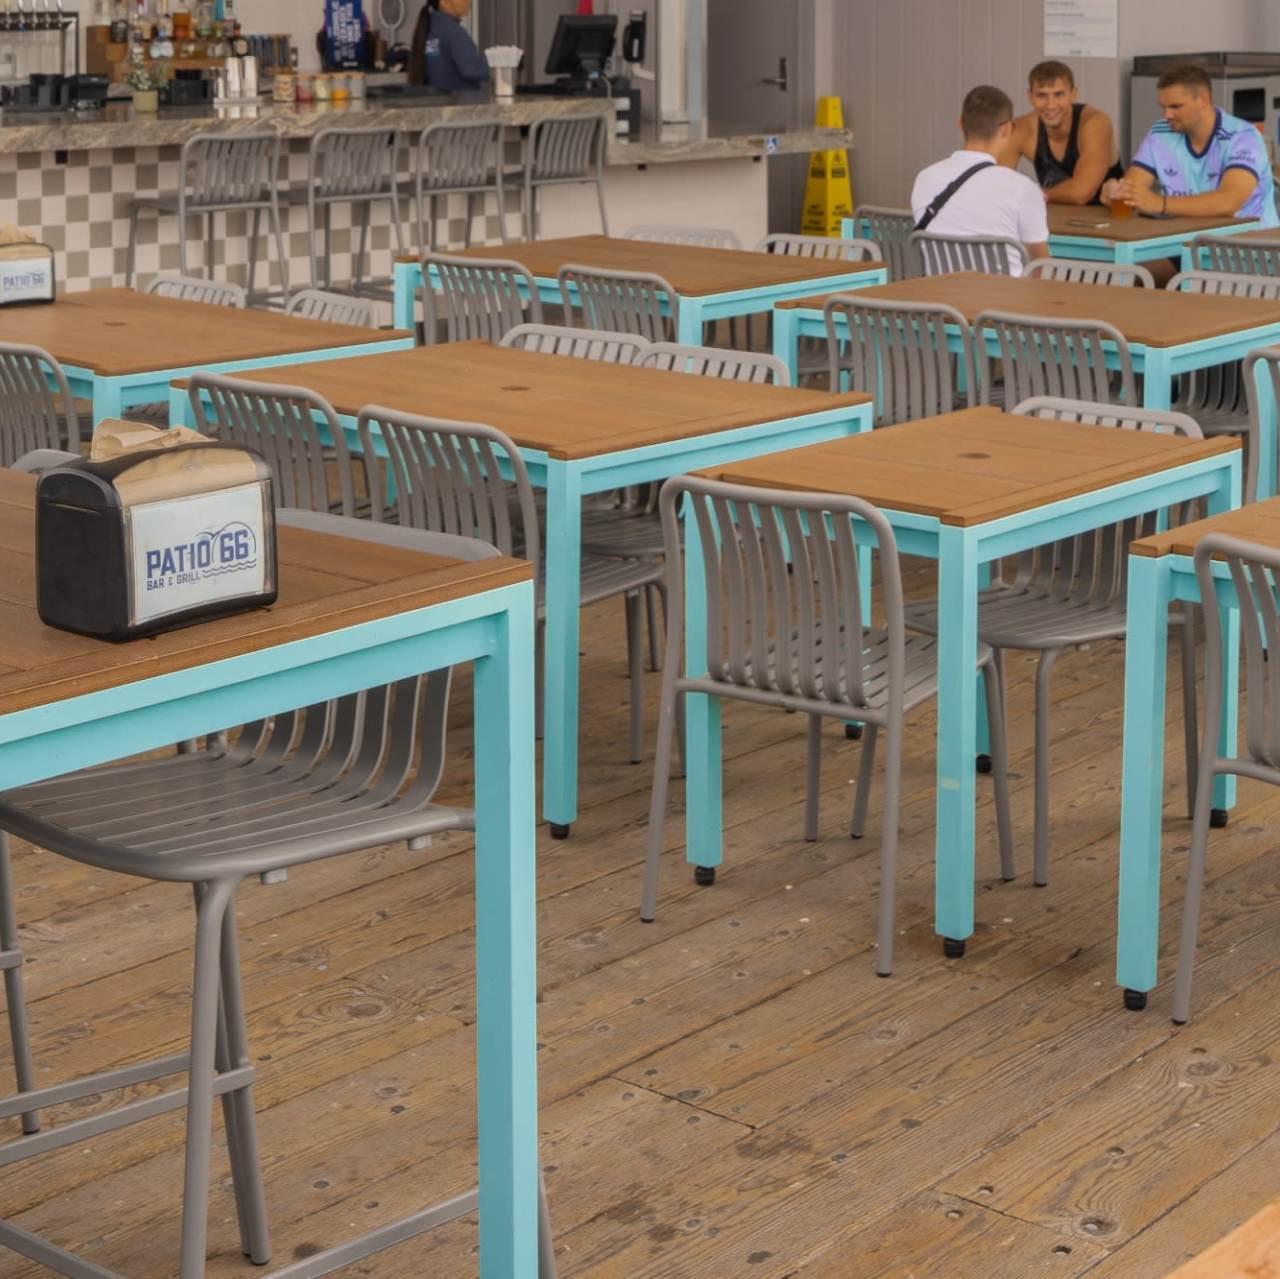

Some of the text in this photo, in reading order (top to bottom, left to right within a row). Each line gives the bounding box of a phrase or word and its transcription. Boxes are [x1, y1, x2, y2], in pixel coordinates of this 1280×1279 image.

[3, 274, 30, 288] PATIO
[146, 529, 249, 579] PATIO 66
[146, 571, 201, 591] BAR & GRILL
